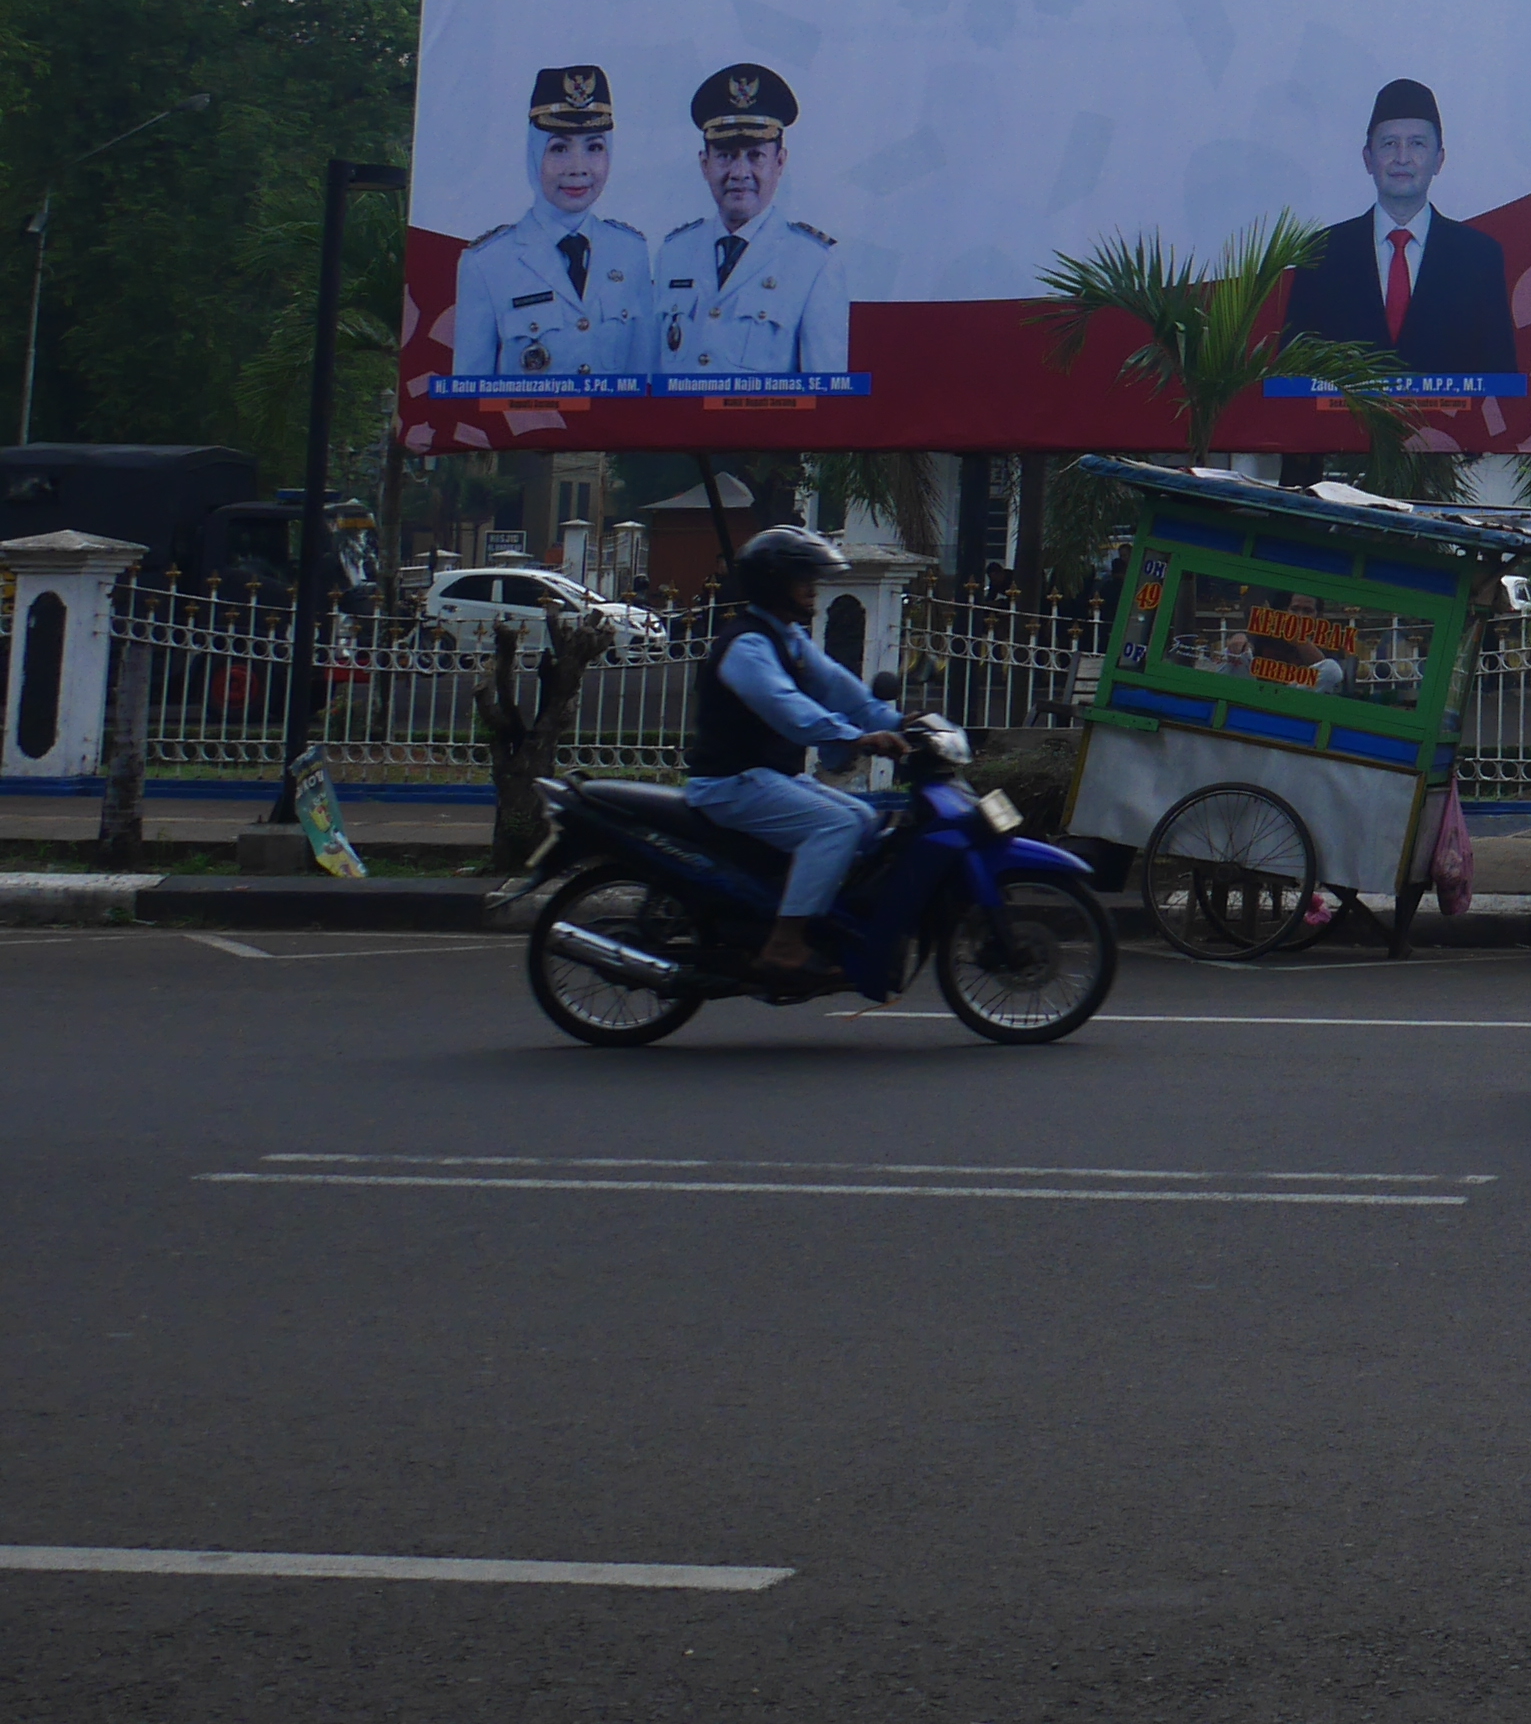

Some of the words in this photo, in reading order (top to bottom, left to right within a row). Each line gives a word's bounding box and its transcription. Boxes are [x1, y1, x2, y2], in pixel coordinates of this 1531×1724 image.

[452, 379, 476, 393] Ratu
[668, 377, 731, 391] Muhammad
[734, 376, 761, 392] Najib
[1135, 582, 1162, 611] 49
[1247, 605, 1359, 654] KETOPRAK
[1250, 656, 1320, 688] CIREBON
